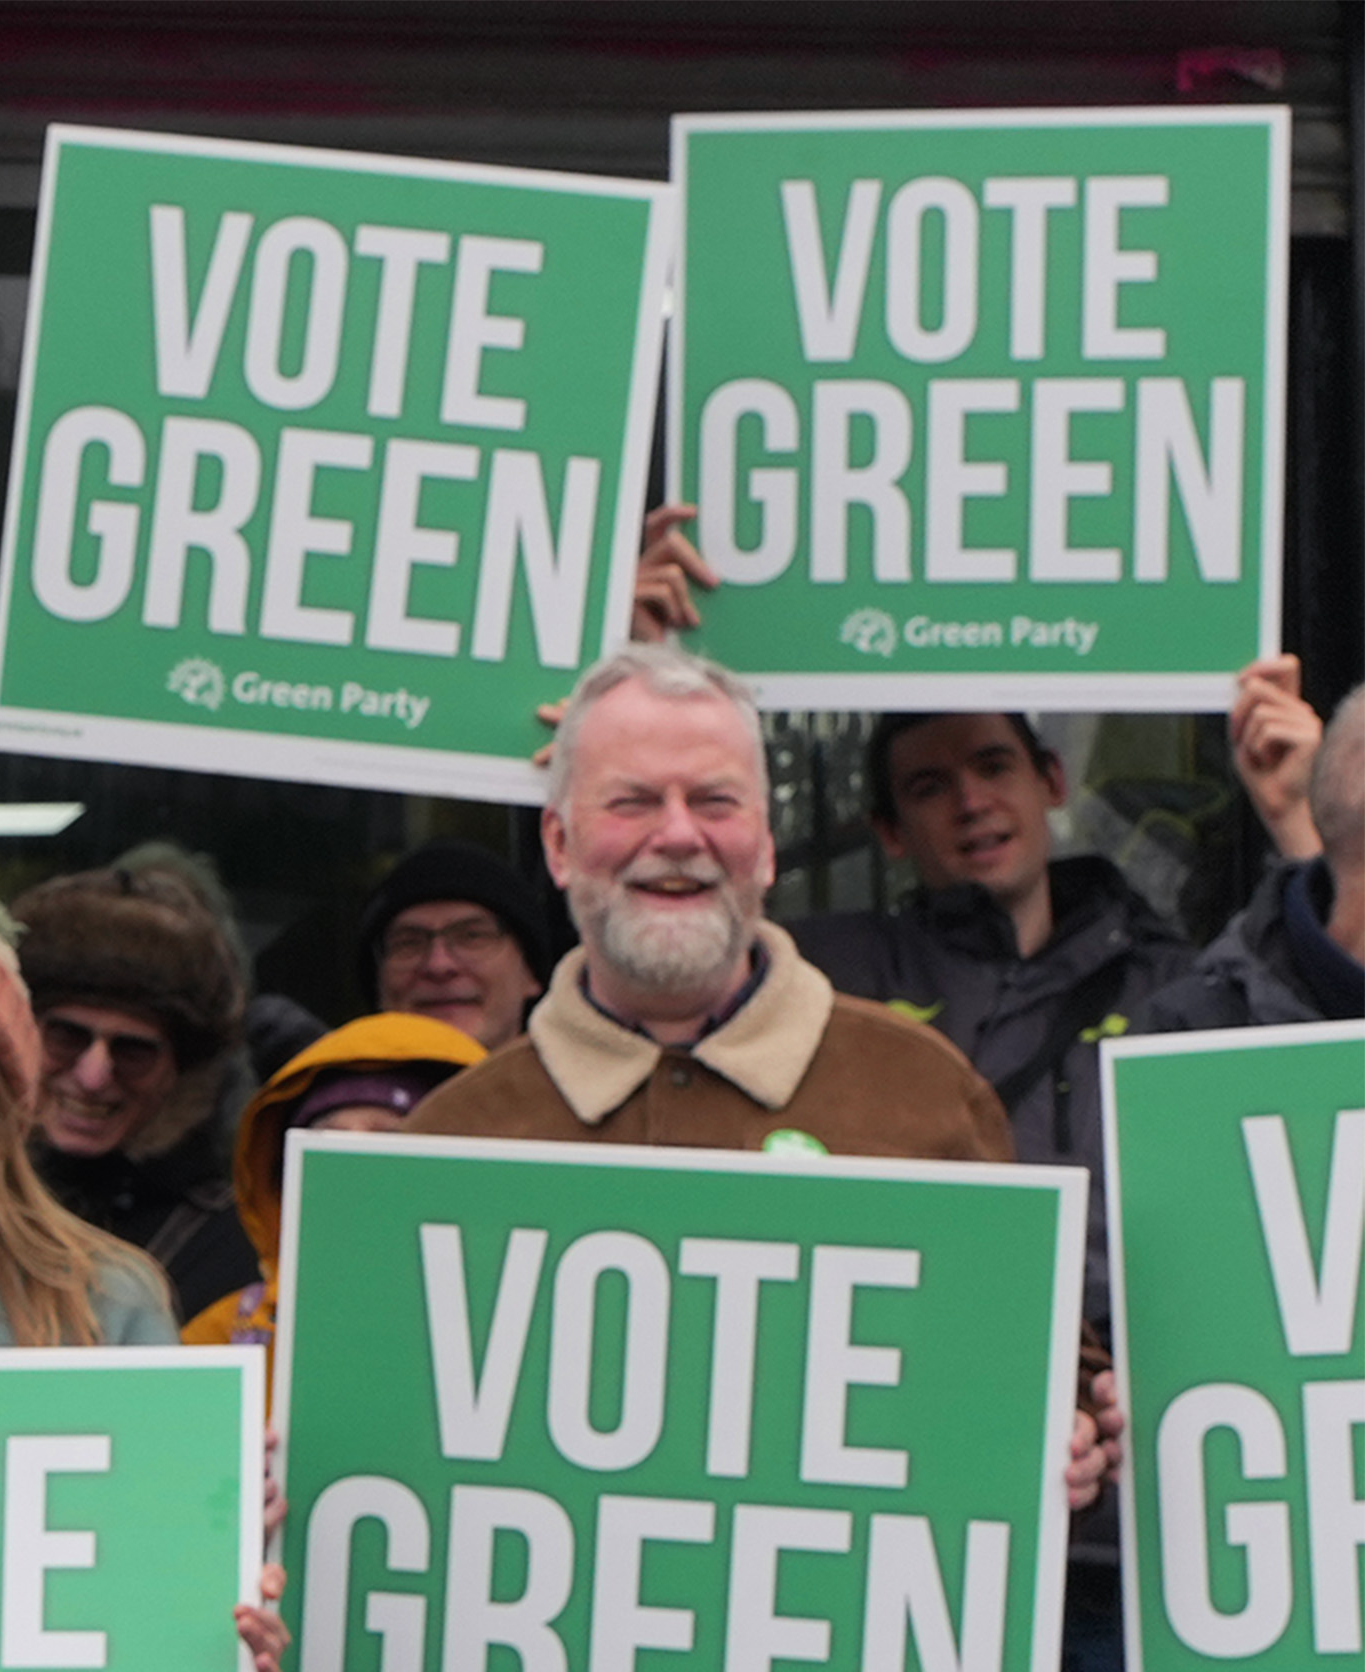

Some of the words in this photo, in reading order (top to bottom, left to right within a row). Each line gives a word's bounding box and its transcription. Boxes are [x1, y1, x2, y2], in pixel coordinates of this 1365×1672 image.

[149, 204, 544, 430] VOTE
[780, 175, 1170, 363] VOTE
[31, 405, 601, 669] GREEN
[697, 376, 1245, 586] GREEN
[231, 671, 332, 712] Green
[340, 681, 430, 729] Party
[904, 616, 1001, 648] Green
[1010, 617, 1099, 656] Party
[419, 1221, 921, 1490] VOTE
